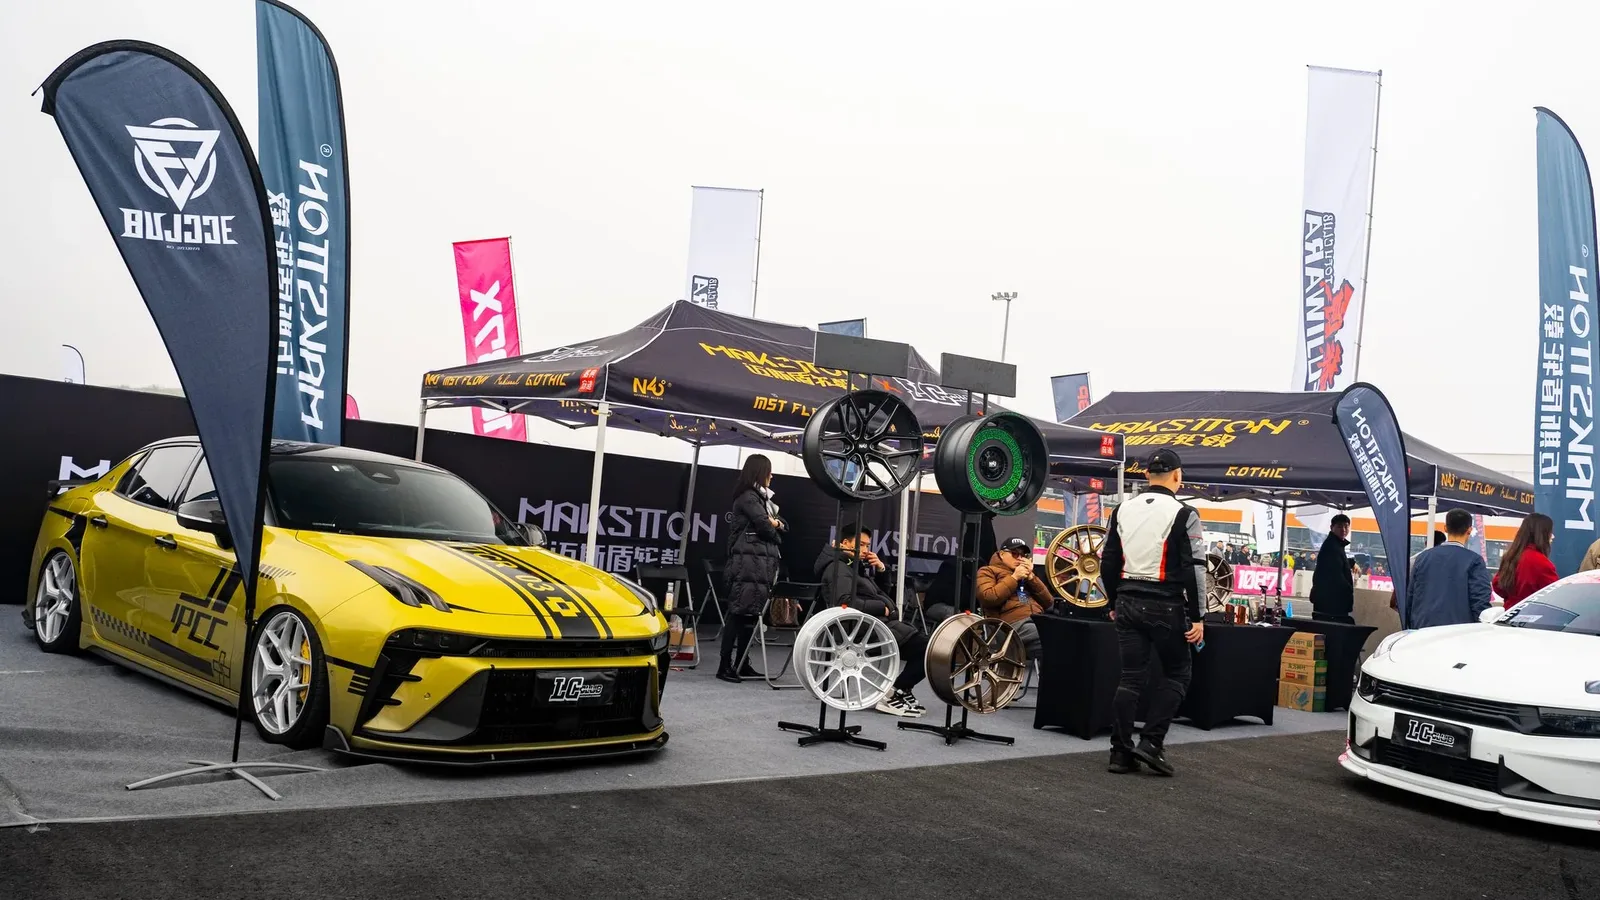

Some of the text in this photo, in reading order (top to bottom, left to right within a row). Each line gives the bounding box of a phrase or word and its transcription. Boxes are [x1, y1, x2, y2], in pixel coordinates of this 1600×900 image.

[525, 373, 571, 386] GOTHIC
[753, 395, 817, 417] MST FL
[1124, 434, 1236, 448] 斯盾轮毂
[1225, 466, 1288, 479] GOTHIC
[518, 497, 718, 543] MAKSTTON
[514, 574, 556, 592] 03
